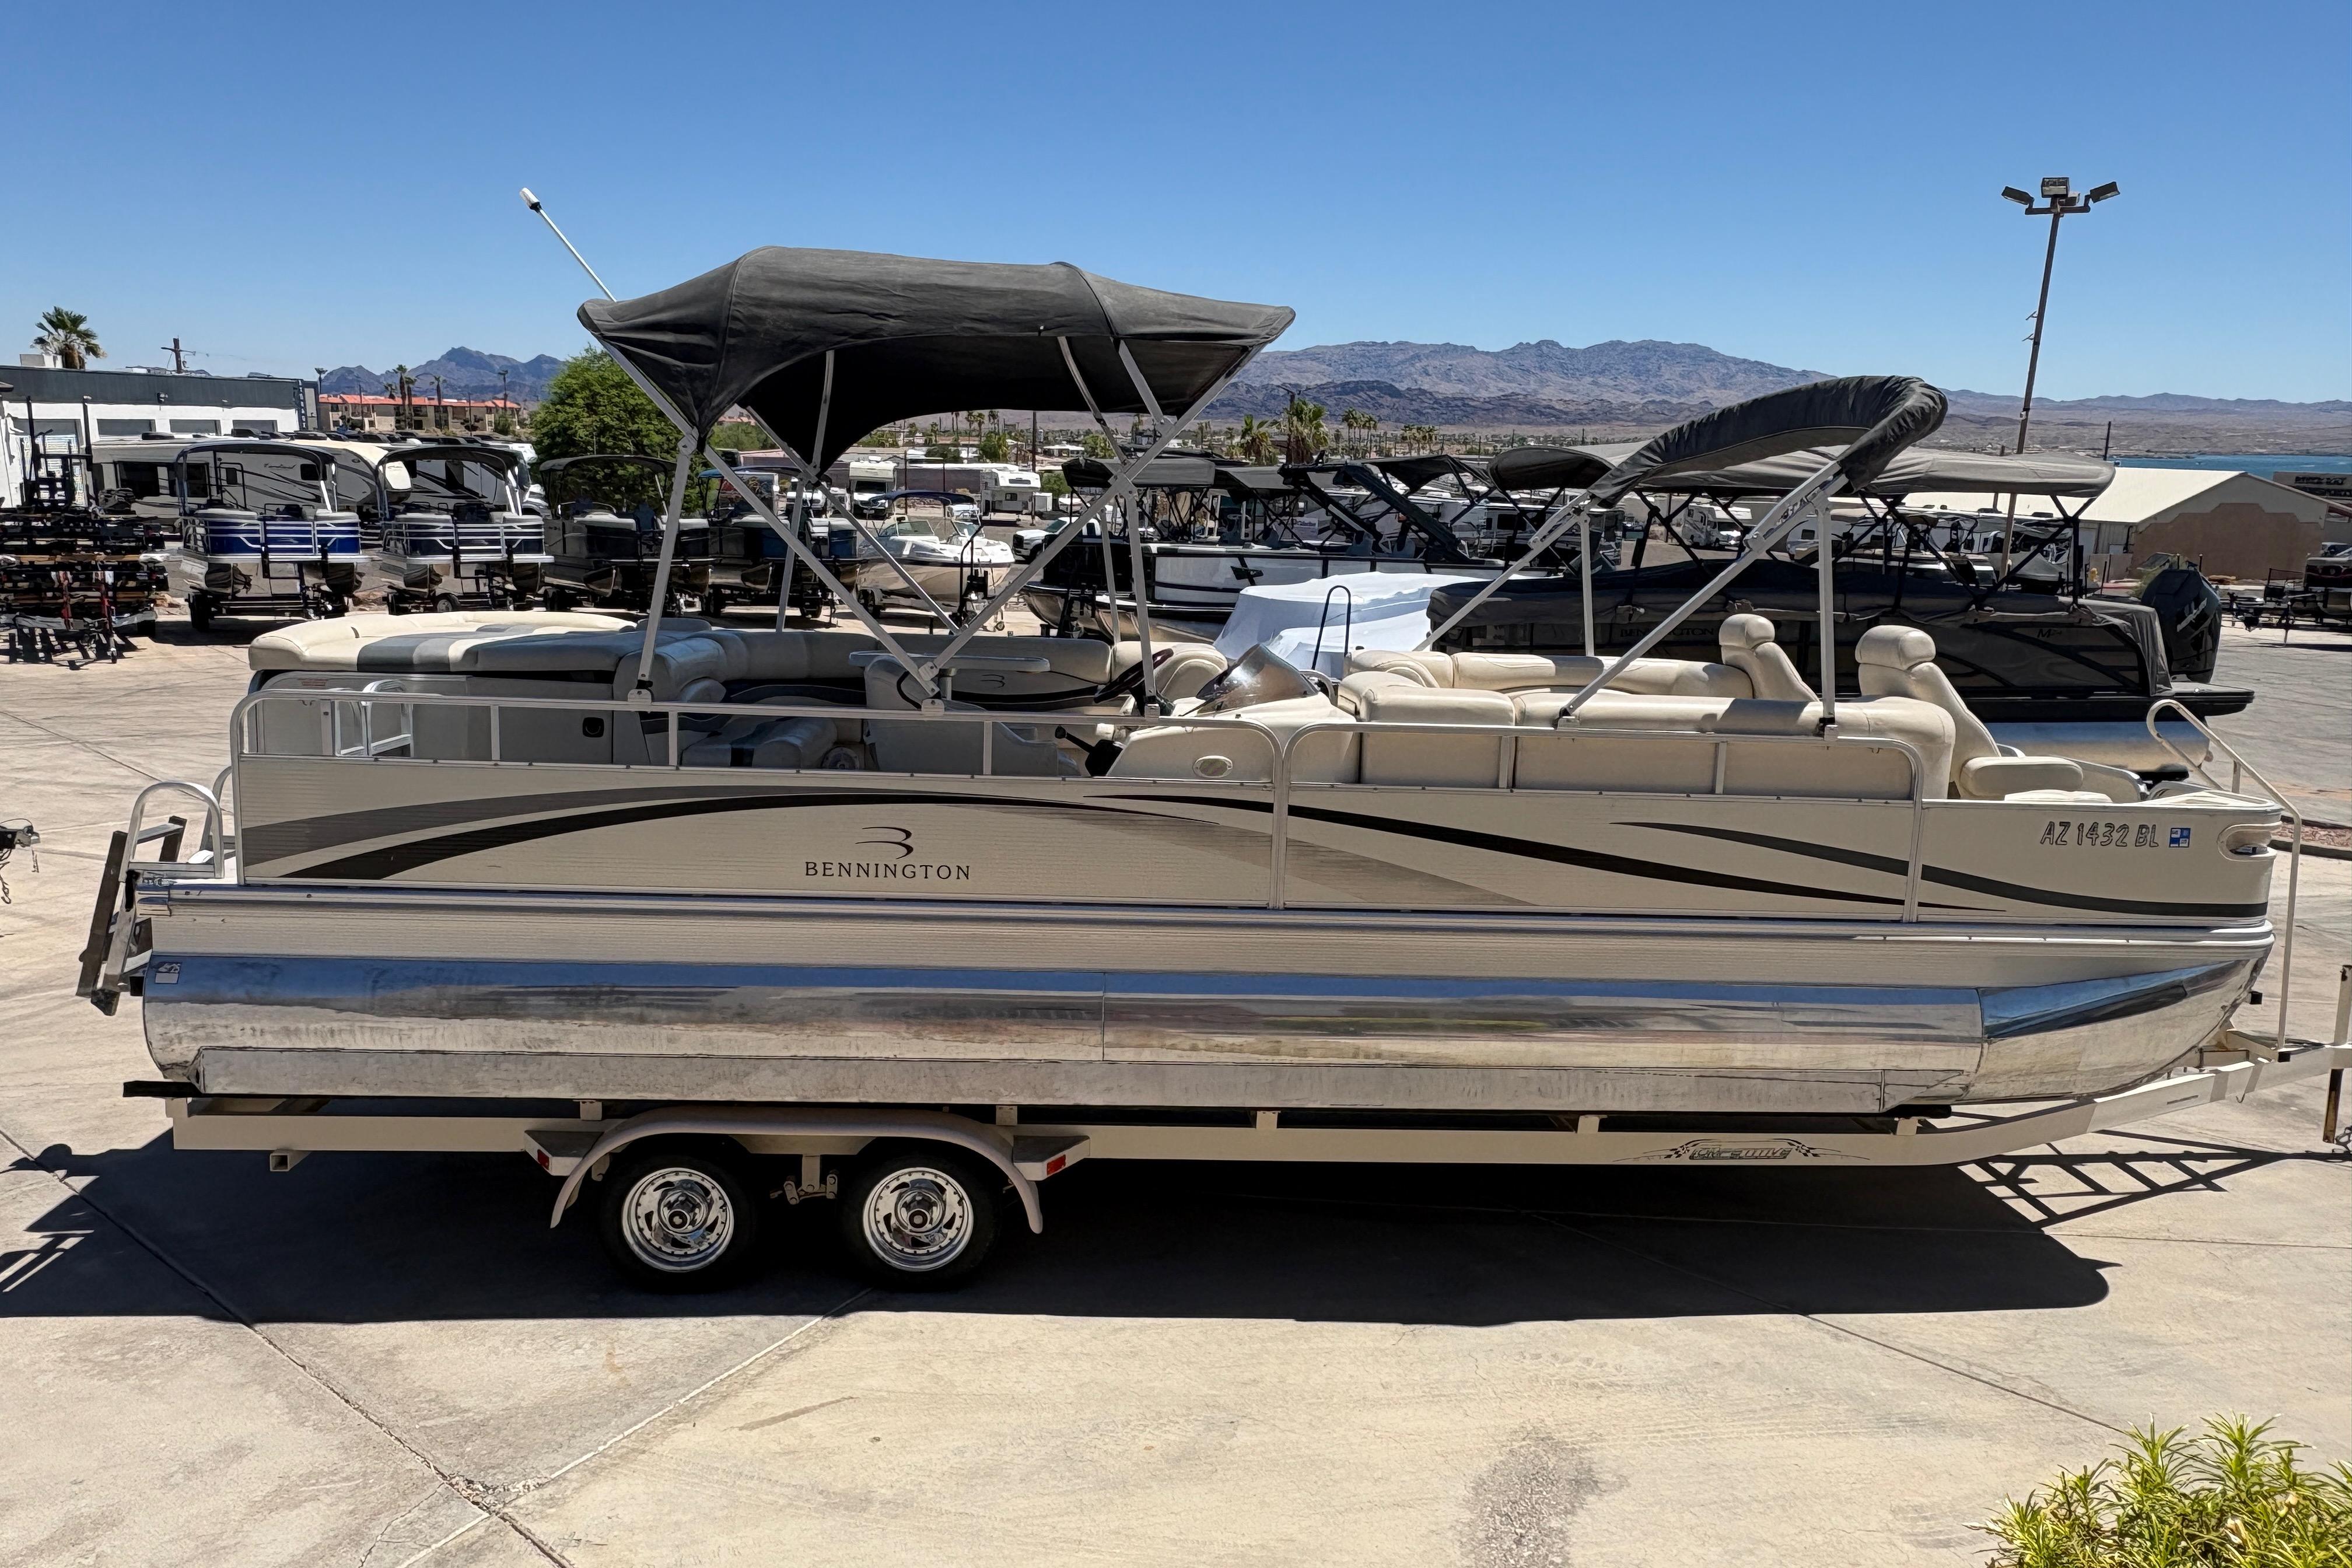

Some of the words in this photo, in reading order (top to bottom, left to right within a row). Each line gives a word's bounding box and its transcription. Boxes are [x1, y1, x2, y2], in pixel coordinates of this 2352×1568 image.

[2040, 821, 2071, 846] AZ
[2077, 821, 2130, 847] 1432
[2134, 824, 2160, 848] BL
[805, 862, 971, 880] BENNINGTON
